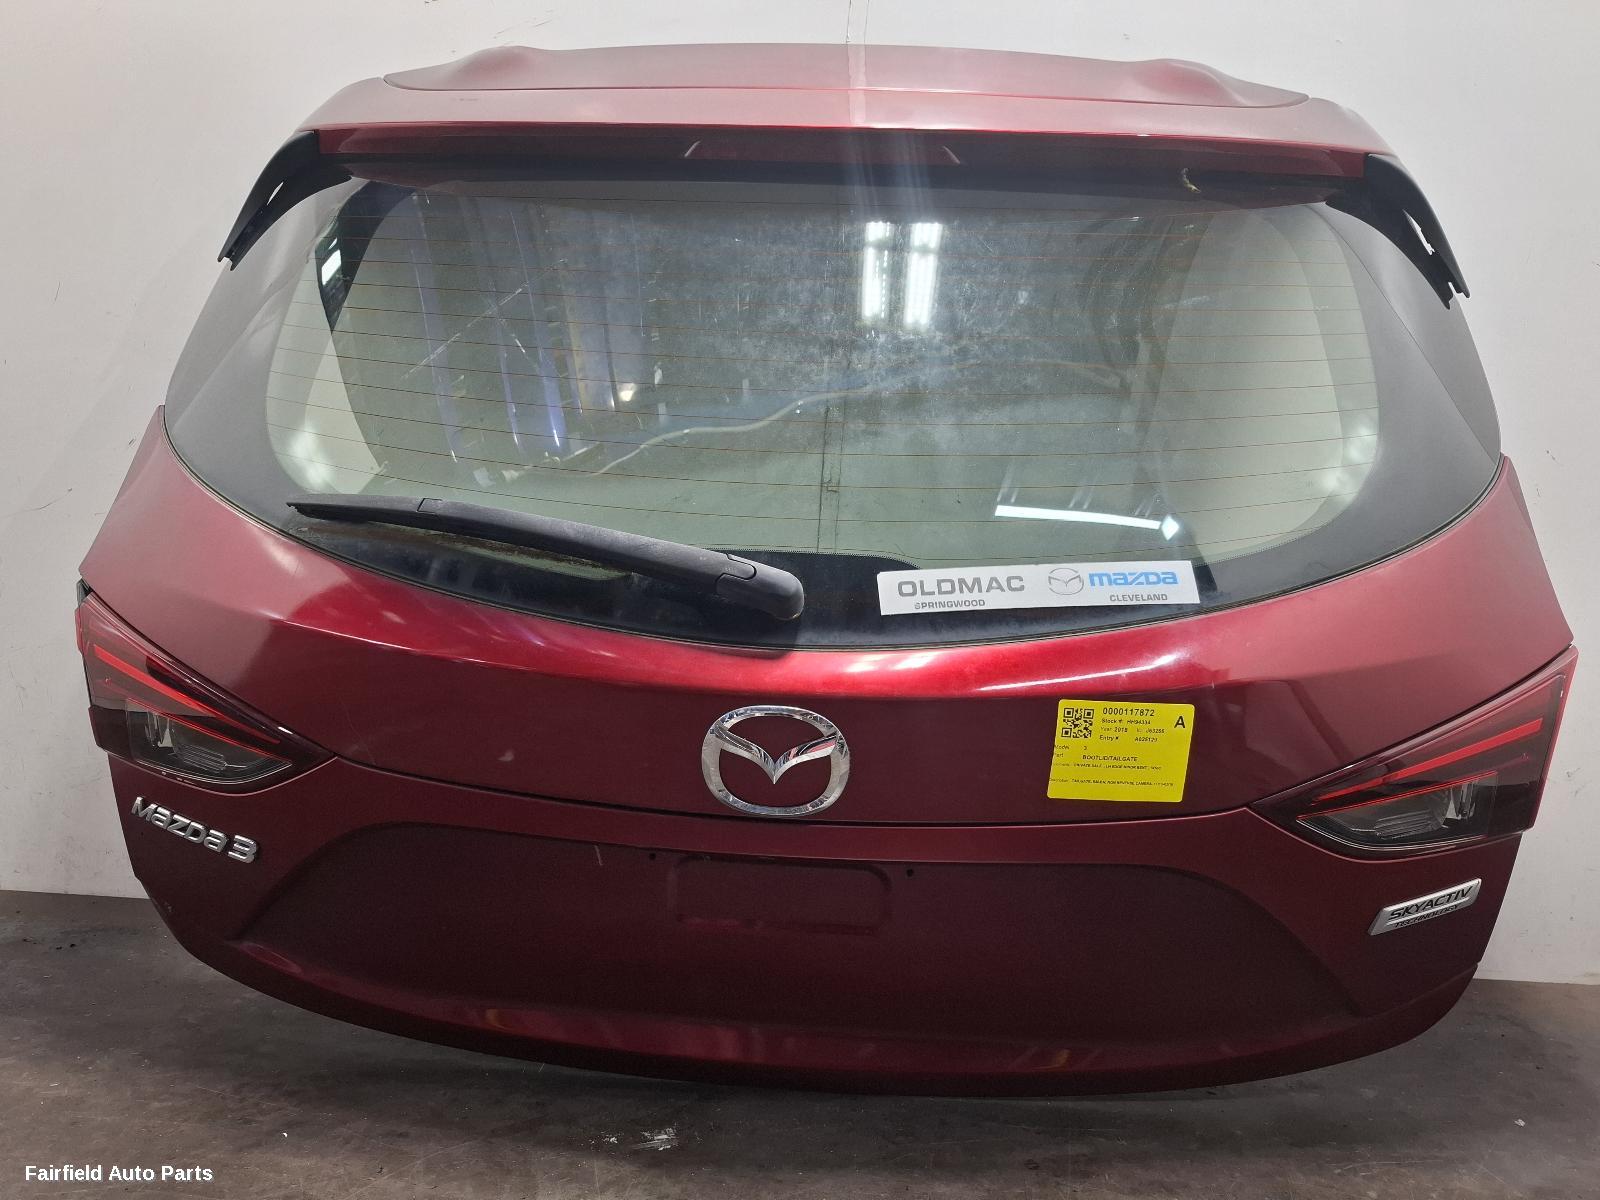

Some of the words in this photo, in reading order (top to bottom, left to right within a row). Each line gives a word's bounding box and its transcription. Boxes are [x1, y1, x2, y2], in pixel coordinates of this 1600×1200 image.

[898, 575, 1025, 597] OLDMAC
[1109, 593, 1168, 603] CLEVELAND
[914, 599, 986, 610] SPRINGWOOD
[1102, 707, 1155, 717] 0000117872
[1174, 715, 1186, 729] A
[1389, 886, 1473, 920] SKYACTIV
